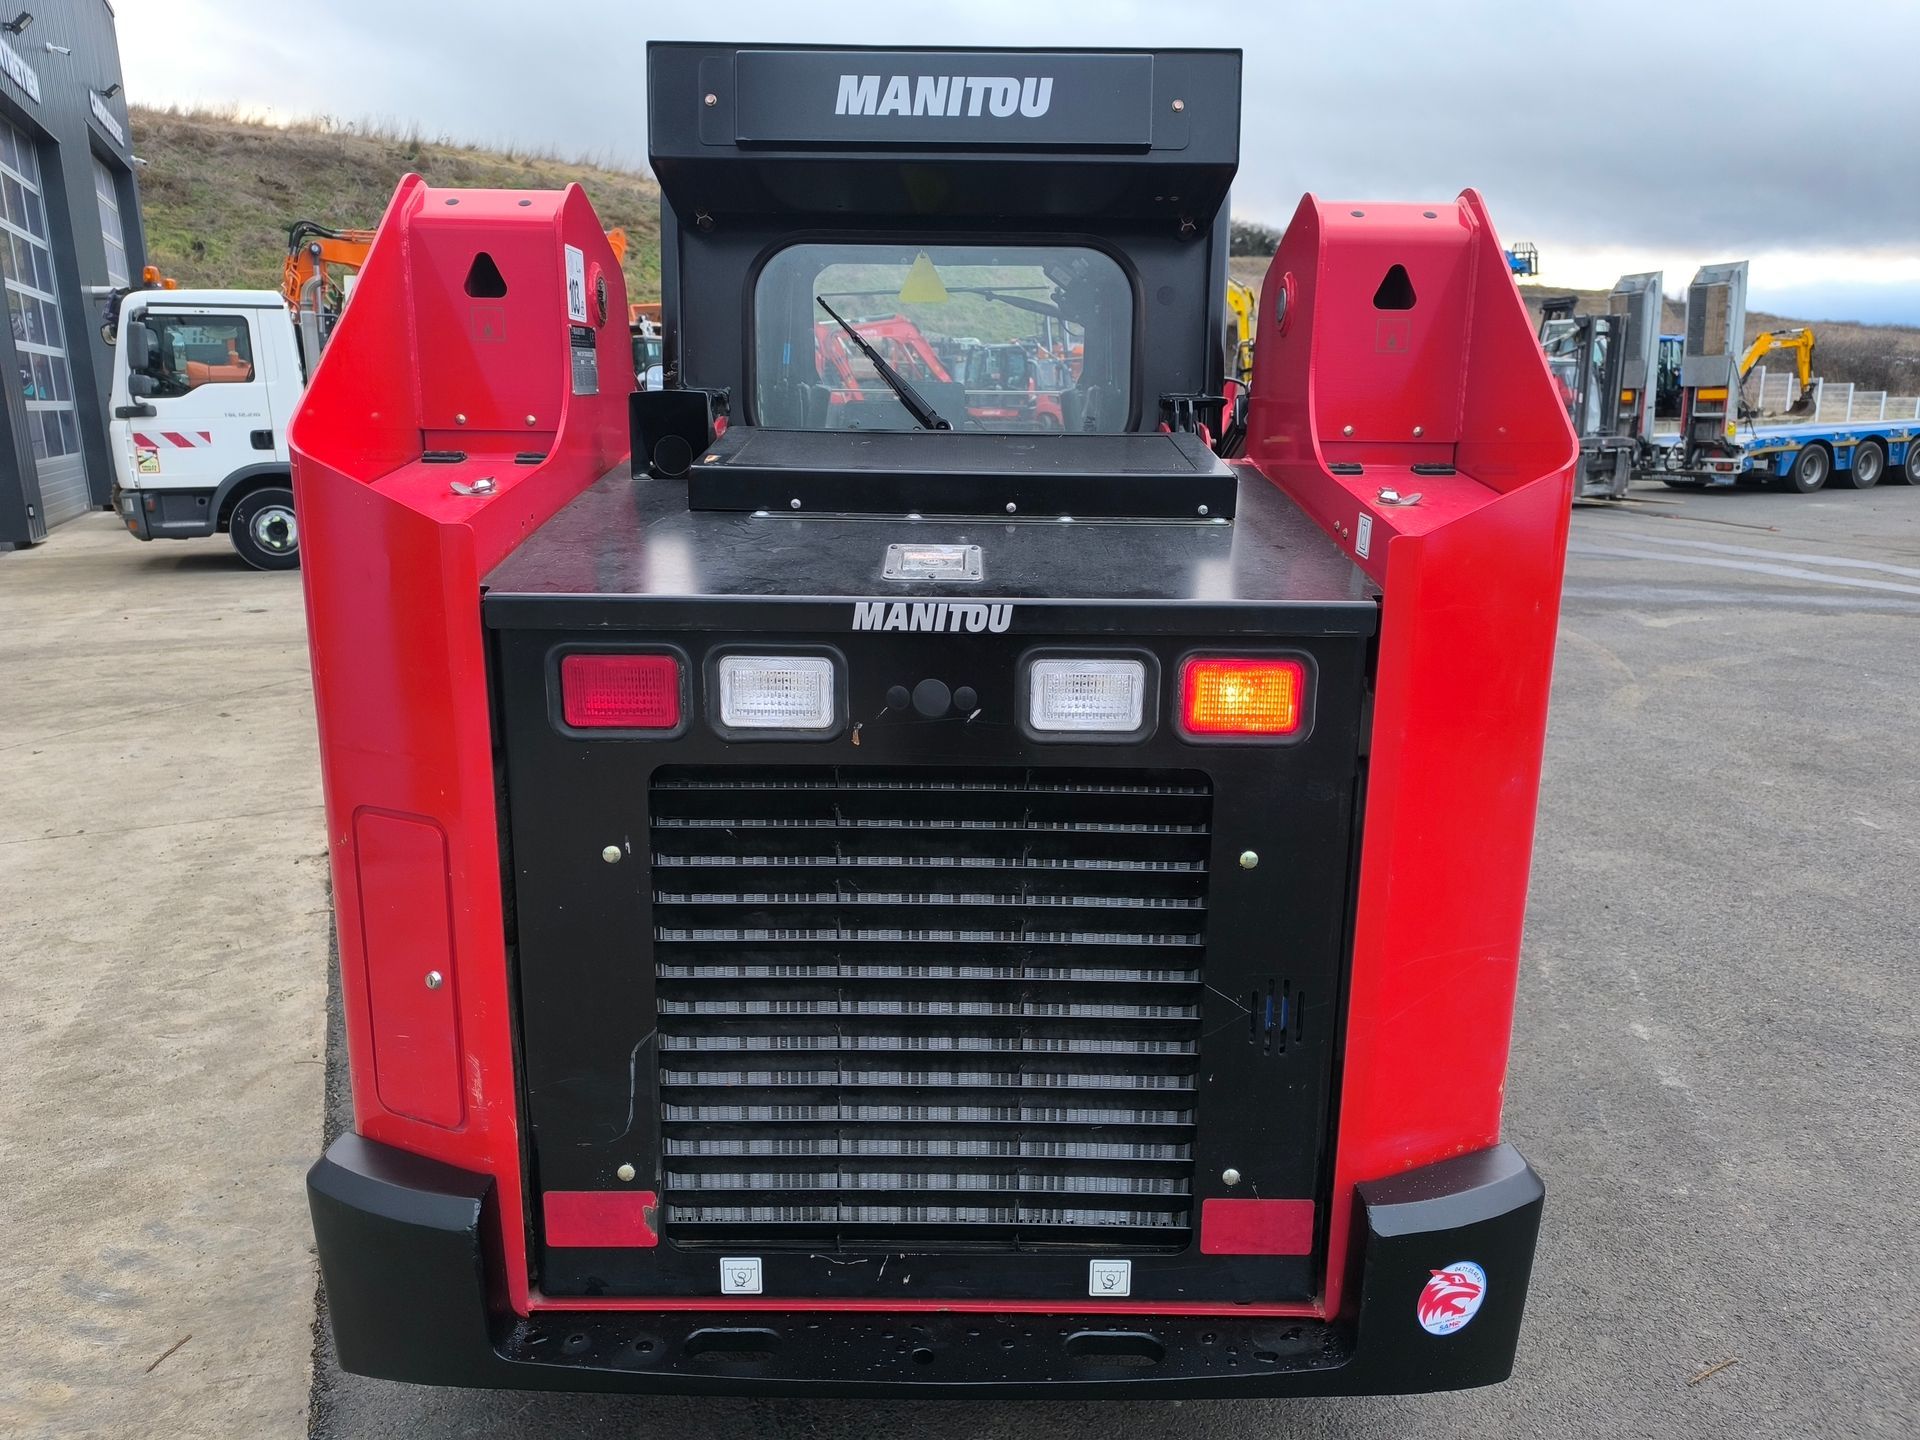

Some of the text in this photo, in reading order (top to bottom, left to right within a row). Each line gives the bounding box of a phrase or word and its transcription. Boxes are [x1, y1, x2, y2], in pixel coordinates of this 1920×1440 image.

[834, 74, 1054, 118] MANITOU
[568, 276, 581, 315] 103
[852, 601, 1013, 633] MANITOU
